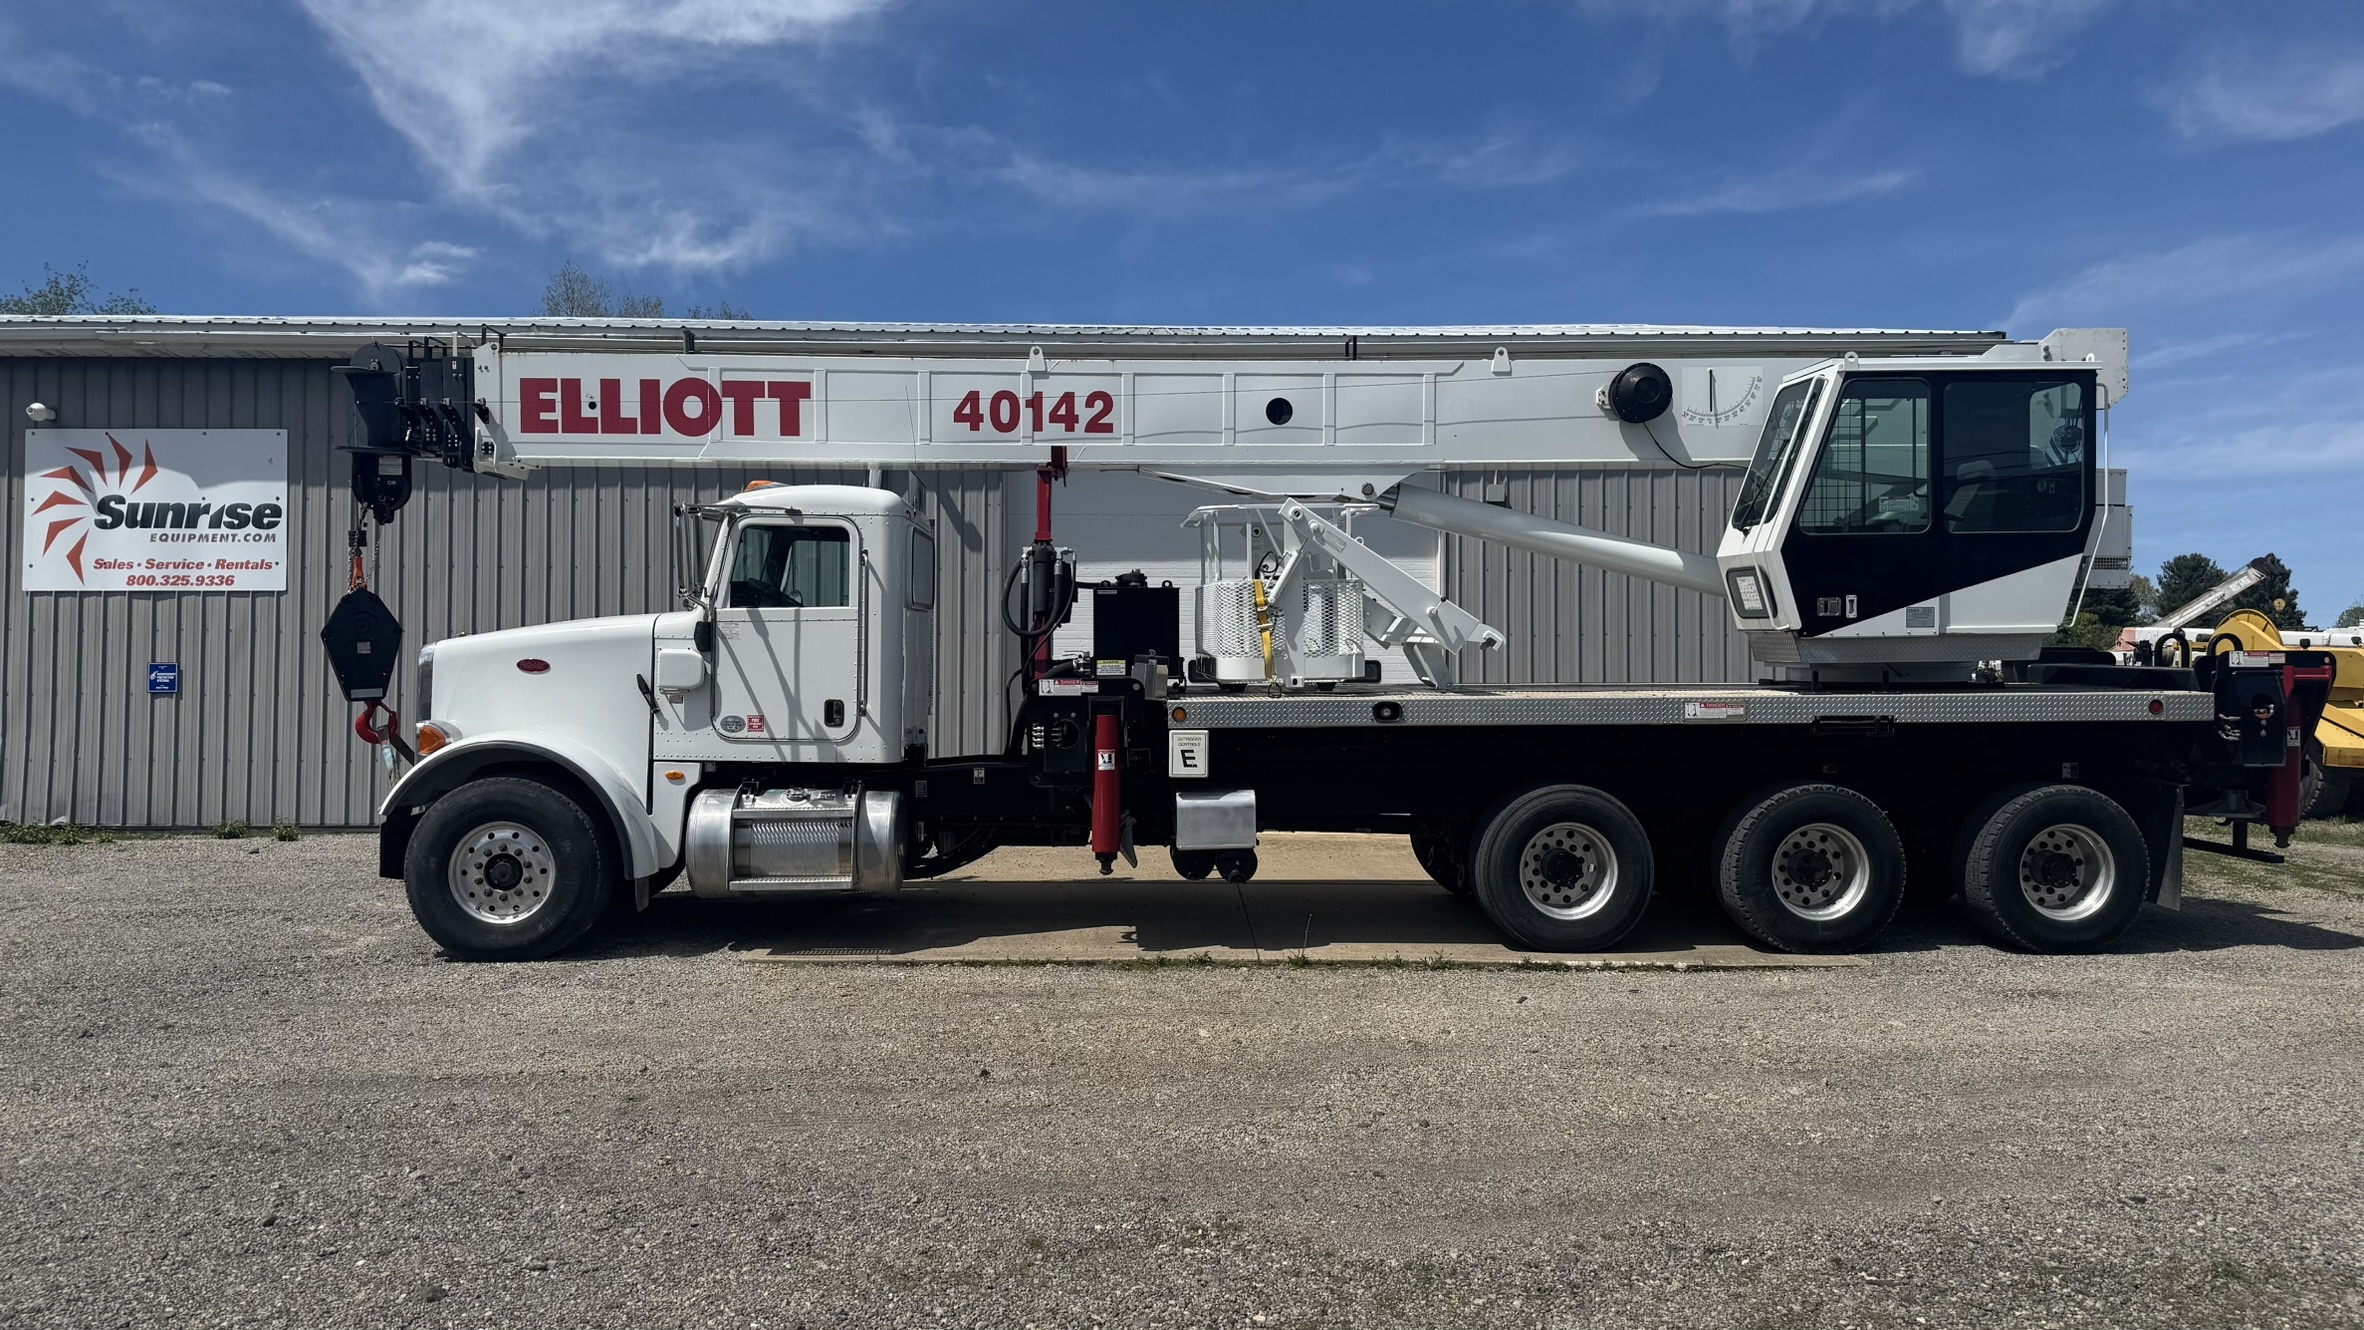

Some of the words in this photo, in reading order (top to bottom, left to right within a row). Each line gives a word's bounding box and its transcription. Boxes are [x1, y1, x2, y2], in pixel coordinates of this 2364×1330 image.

[520, 377, 812, 437] ELLIOTT
[953, 390, 1114, 433] 40142
[94, 494, 282, 530] Sunrise
[150, 533, 276, 543] EQUIPMENT.COM
[93, 558, 134, 570] Sales
[144, 558, 204, 570] Service
[214, 558, 273, 570] Rentals
[126, 574, 235, 586] 800.325.9336
[1180, 749, 1198, 768] E
